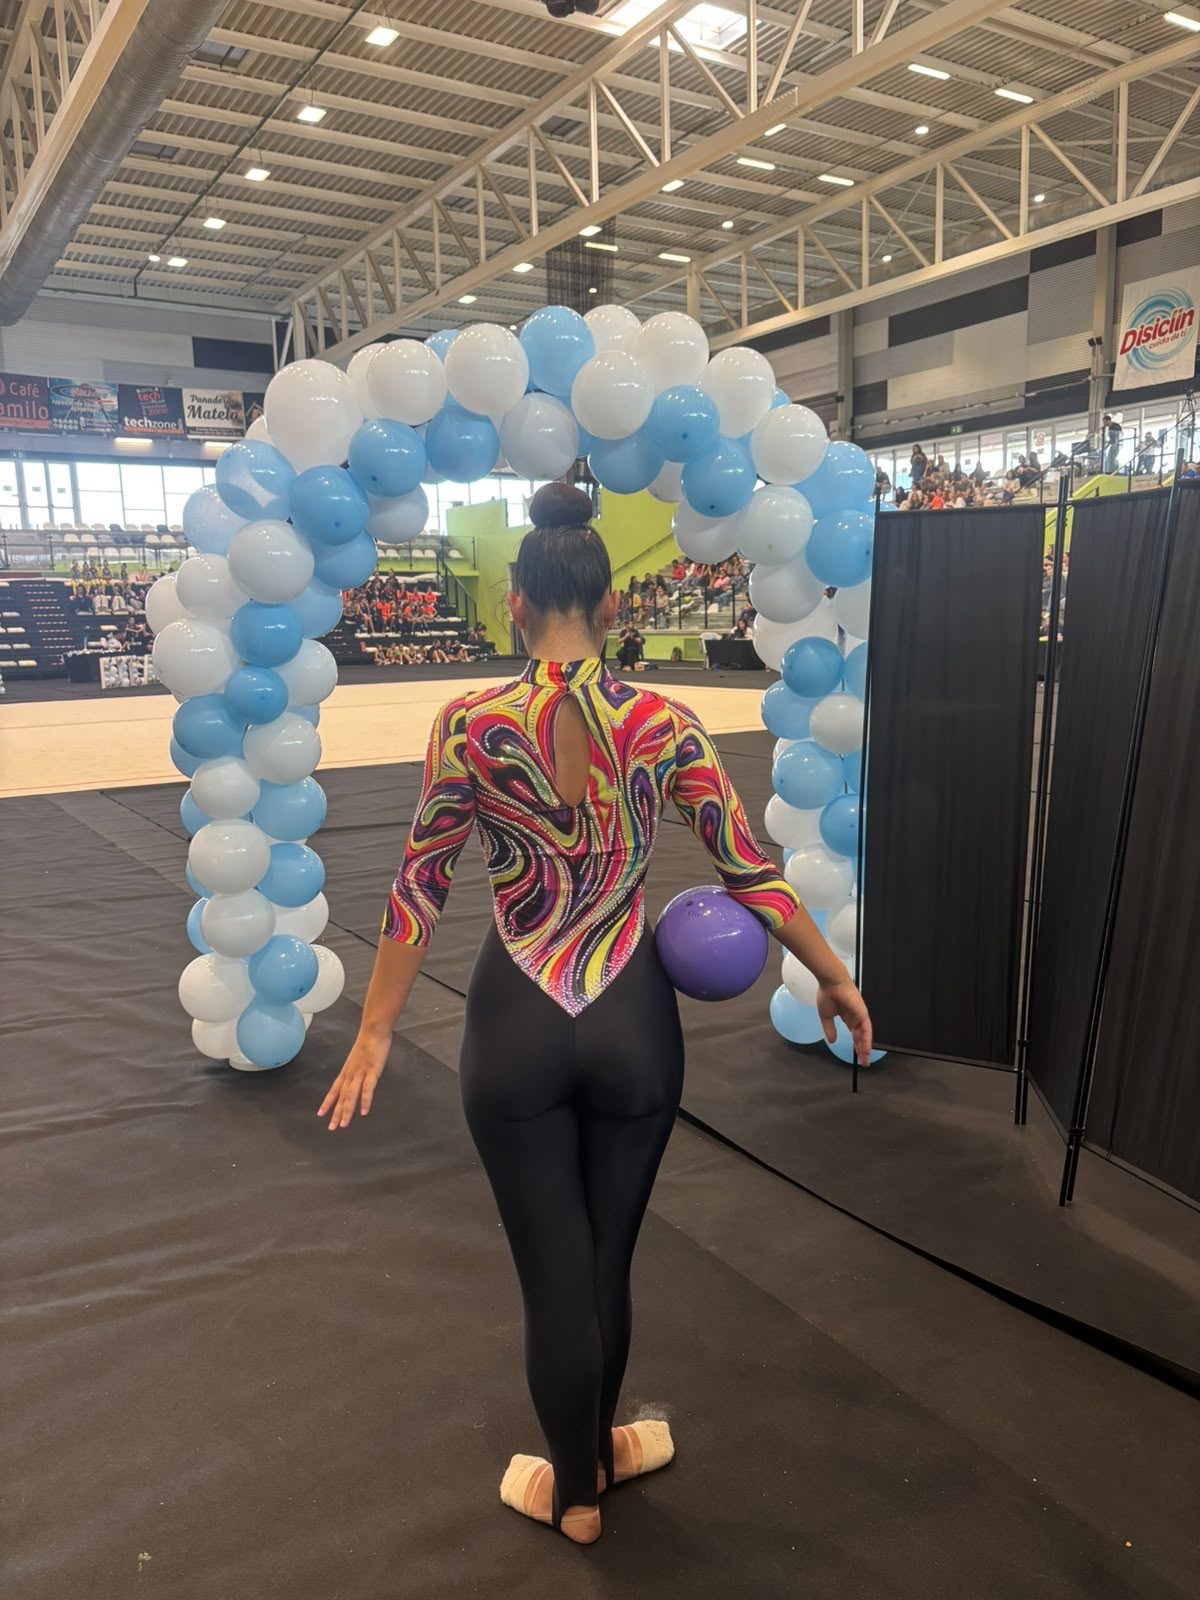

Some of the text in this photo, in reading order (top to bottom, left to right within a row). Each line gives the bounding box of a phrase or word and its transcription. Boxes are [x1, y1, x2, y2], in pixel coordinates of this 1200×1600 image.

[1120, 308, 1195, 355] Disiclin
[1149, 336, 1170, 348] cuida
[1171, 333, 1180, 341] de
[9, 381, 40, 398] Café
[124, 416, 177, 430] techzone
